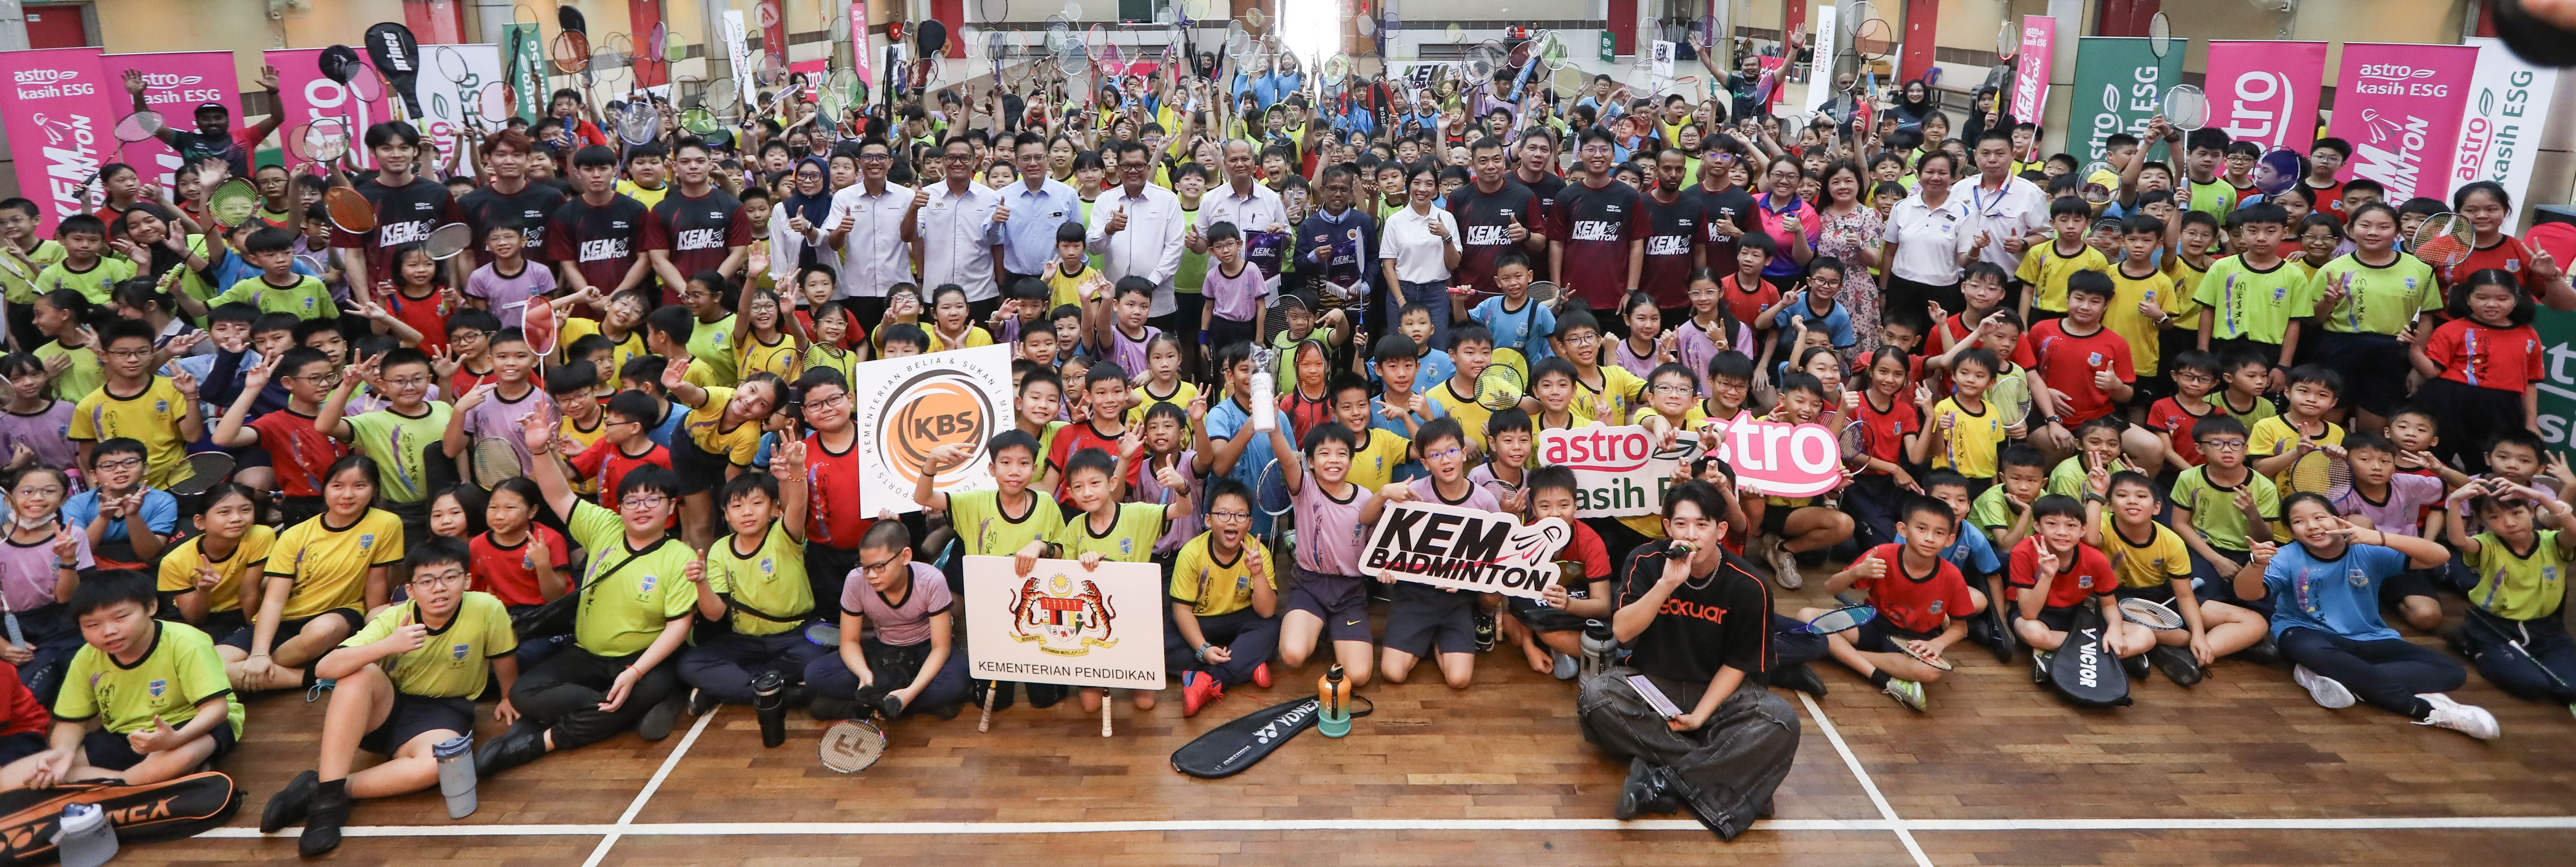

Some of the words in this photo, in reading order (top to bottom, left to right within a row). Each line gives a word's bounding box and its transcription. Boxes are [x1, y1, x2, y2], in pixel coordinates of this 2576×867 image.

[2026, 27, 2038, 36] astro
[383, 32, 412, 71] prince
[1655, 44, 1667, 59] KEM
[2037, 39, 2047, 47] ESG
[528, 40, 541, 70] ESG
[15, 69, 58, 82] astro
[142, 73, 179, 86] stro
[1403, 66, 1449, 81] KEM
[2360, 64, 2410, 77] astro
[18, 85, 60, 100] kasih
[63, 83, 95, 97] ESG
[184, 89, 221, 102] ESG
[523, 73, 537, 114] astro
[2131, 66, 2158, 111] ESG
[2357, 81, 2404, 96] kasih
[2410, 83, 2448, 97] ESG
[2503, 71, 2533, 117] ESG
[2015, 73, 2032, 123] KEM
[2457, 117, 2486, 181] astro
[2492, 125, 2519, 186] kasih
[43, 146, 86, 222] KEM
[382, 221, 420, 240] KEM
[678, 229, 713, 243] KEM
[1468, 226, 1502, 239] KEM
[1572, 233, 1619, 242] BADMINTON
[1574, 221, 1608, 237] KEM
[581, 239, 616, 256] KEM
[677, 241, 725, 250] BADMINTON
[1467, 237, 1512, 245] BADMINTON
[1647, 235, 1682, 250] KEM
[580, 251, 629, 263] BADMINTON
[1646, 246, 1690, 255] BADMINTON
[864, 373, 900, 454] KEMENTERIAN
[907, 358, 941, 372] BELIA
[963, 361, 995, 385] SUKAN
[915, 411, 973, 442] KBS
[1546, 430, 1649, 464] astro
[1709, 414, 1837, 475] stro
[1577, 477, 1644, 511] asih
[1377, 507, 1512, 564] KEM
[1366, 547, 1552, 592] BADMINTON
[1041, 646, 1060, 655] BERTAMBAH
[979, 661, 1071, 677] KEMENTERIAN
[1075, 667, 1155, 681] PENDIDIKAN
[2079, 642, 2097, 688] VICTOR
[1276, 699, 1320, 727] YONEX
[105, 796, 179, 824] NEX
